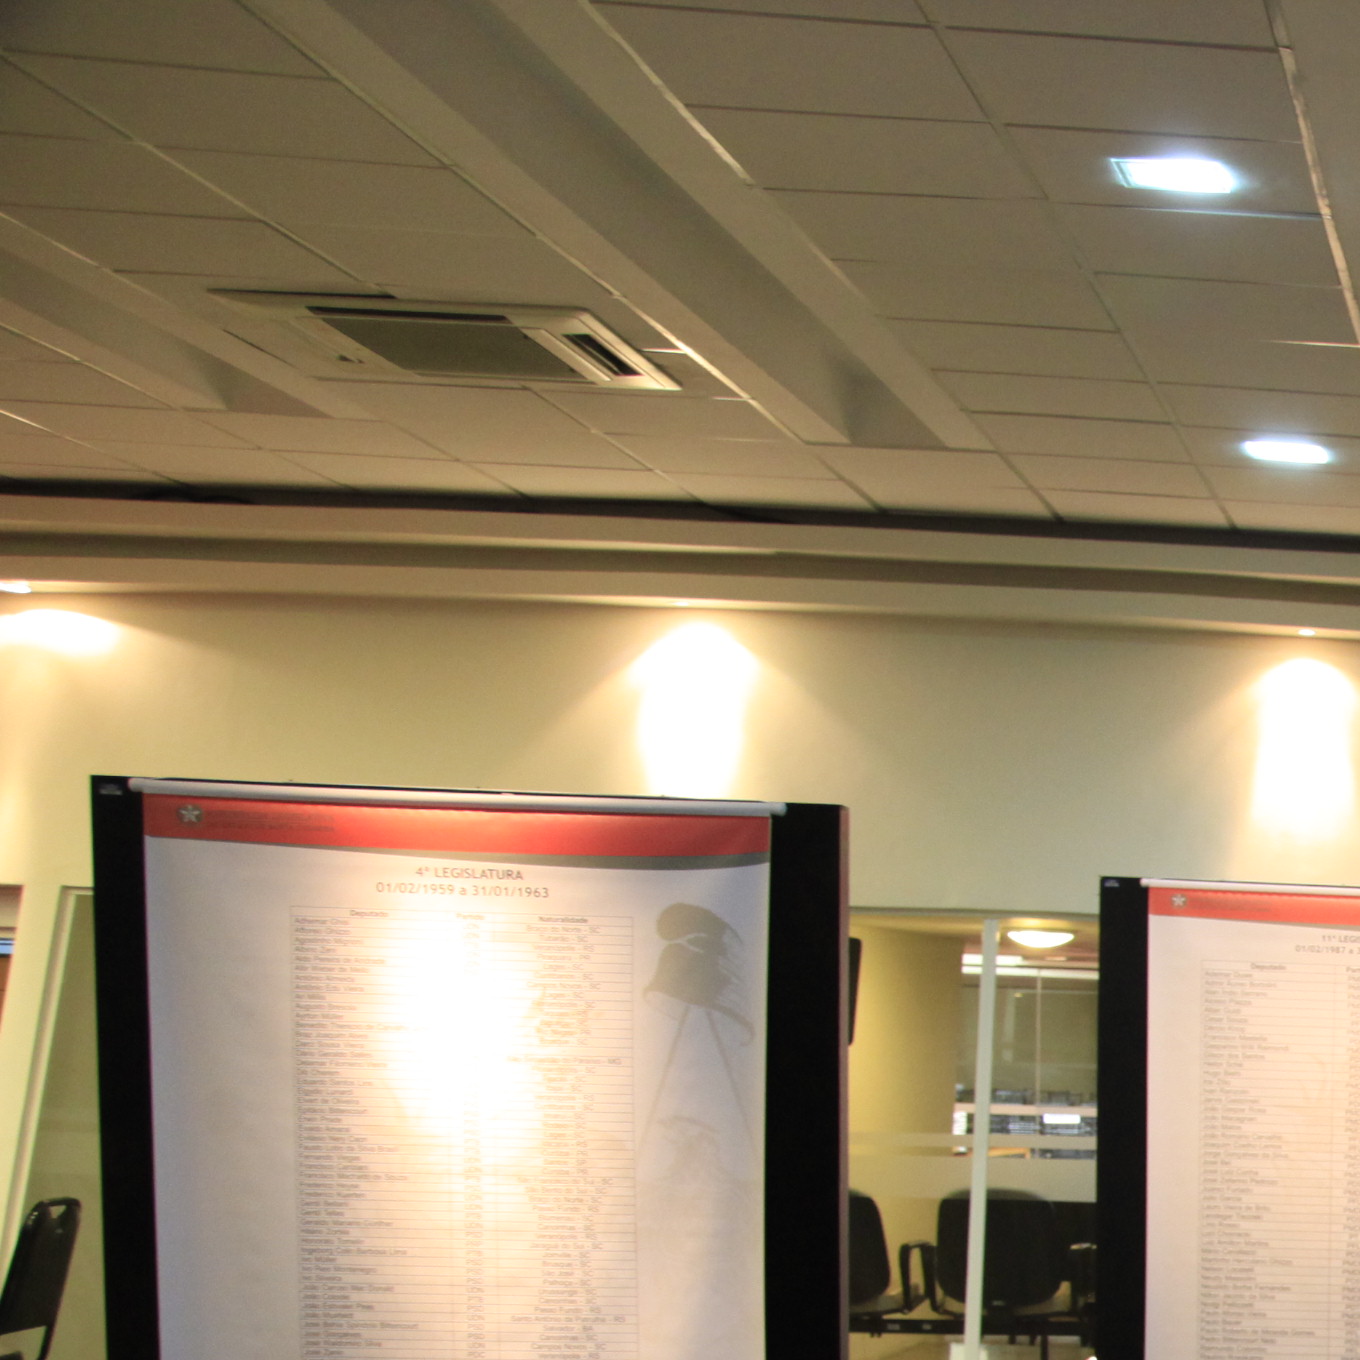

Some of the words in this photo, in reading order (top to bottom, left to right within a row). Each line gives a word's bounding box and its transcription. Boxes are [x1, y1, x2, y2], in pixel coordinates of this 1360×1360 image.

[434, 868, 524, 880] LEGISLATURA
[376, 882, 454, 895] 01/02/1959
[459, 888, 467, 896] a
[472, 886, 550, 899] 31/01/1963
[349, 909, 389, 918] Deputado
[538, 915, 588, 924] Naturalidade
[1295, 945, 1346, 954] 01/02/1987
